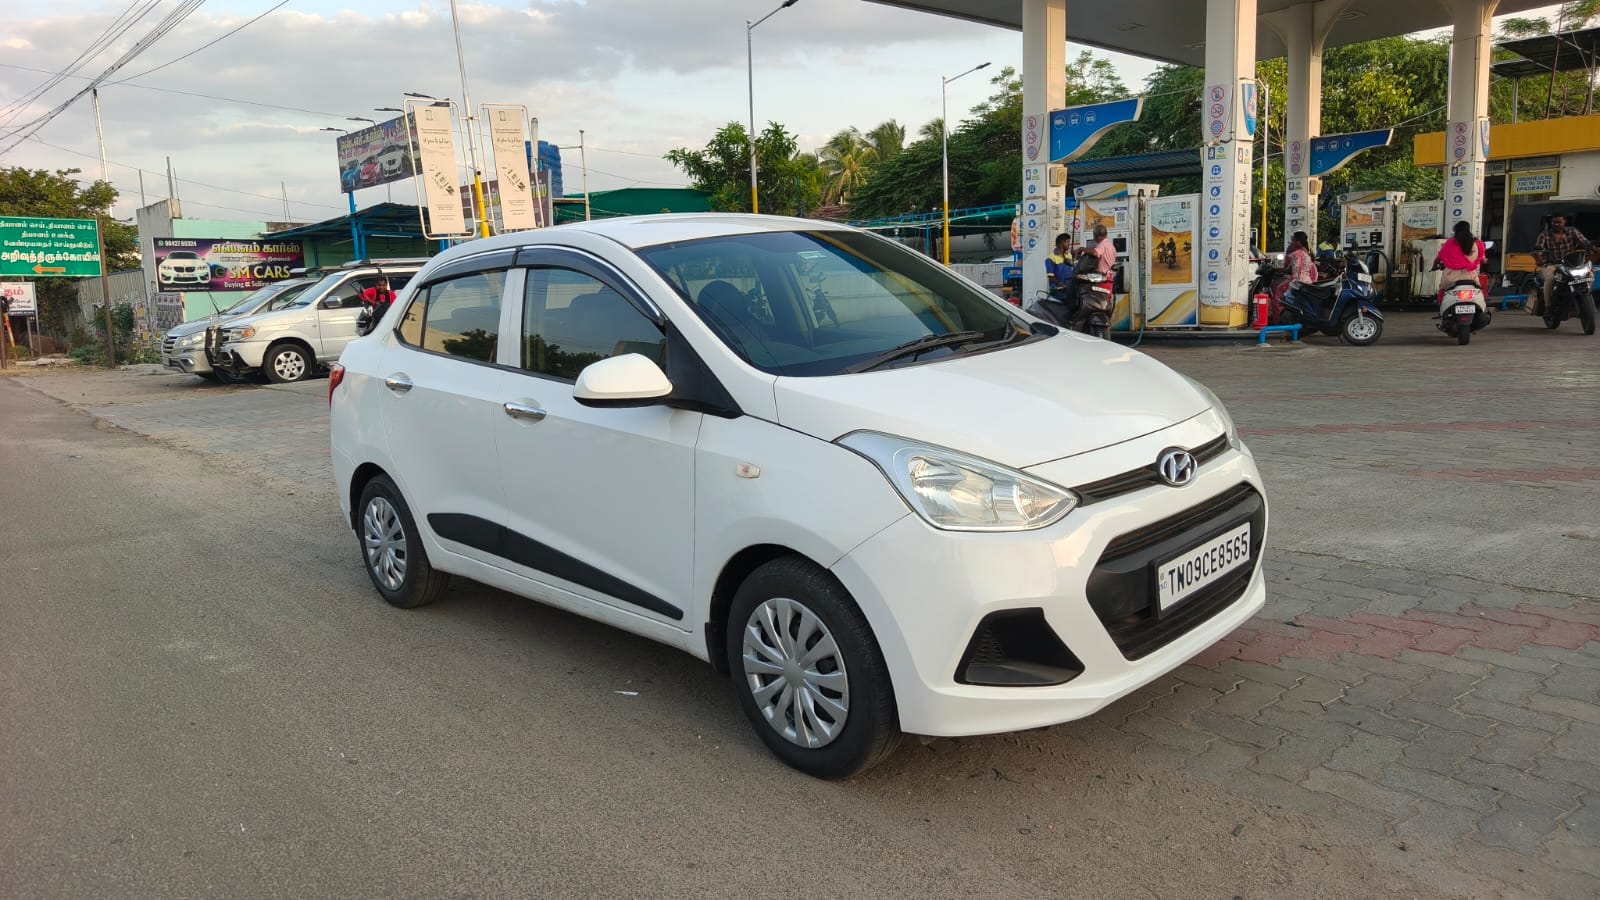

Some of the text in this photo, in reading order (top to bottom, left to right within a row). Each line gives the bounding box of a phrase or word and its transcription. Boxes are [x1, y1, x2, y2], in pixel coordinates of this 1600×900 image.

[1317, 160, 1322, 168] 3
[229, 265, 291, 279] SM CARS
[1168, 531, 1248, 596] TN09CE8565
